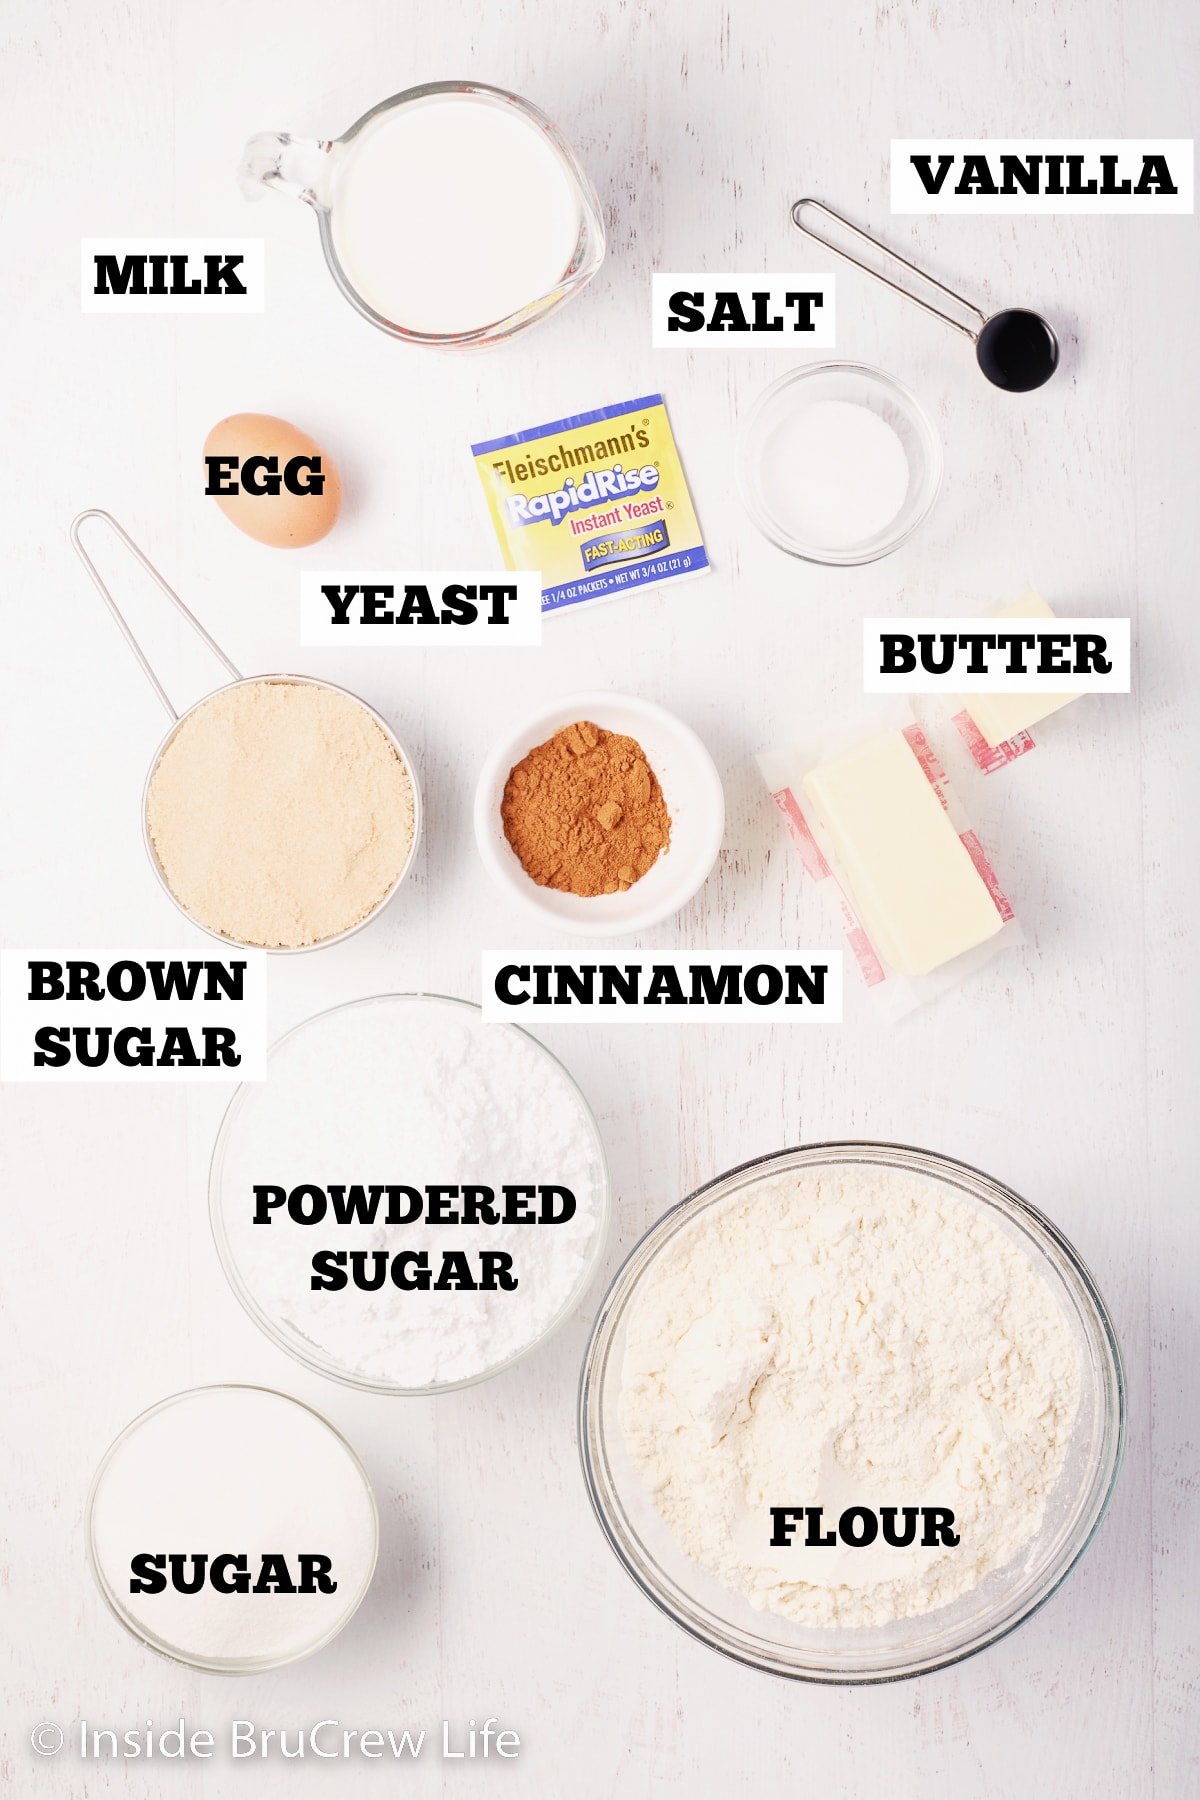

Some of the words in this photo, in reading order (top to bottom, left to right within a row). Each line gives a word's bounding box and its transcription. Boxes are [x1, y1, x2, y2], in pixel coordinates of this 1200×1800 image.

[493, 424, 651, 484] Fleischmann's
[505, 464, 660, 527] RapidRise
[571, 507, 622, 535] Instant
[623, 496, 664, 519] Yeast
[584, 529, 664, 563] FAST-ACTING
[541, 594, 551, 605] EE
[551, 590, 566, 603] 1/4
[566, 586, 578, 598] OZ
[578, 578, 608, 596] PACKETS
[614, 572, 628, 584] NET
[628, 568, 640, 581] WT
[641, 565, 656, 578] 3/4
[657, 561, 669, 573] OZ
